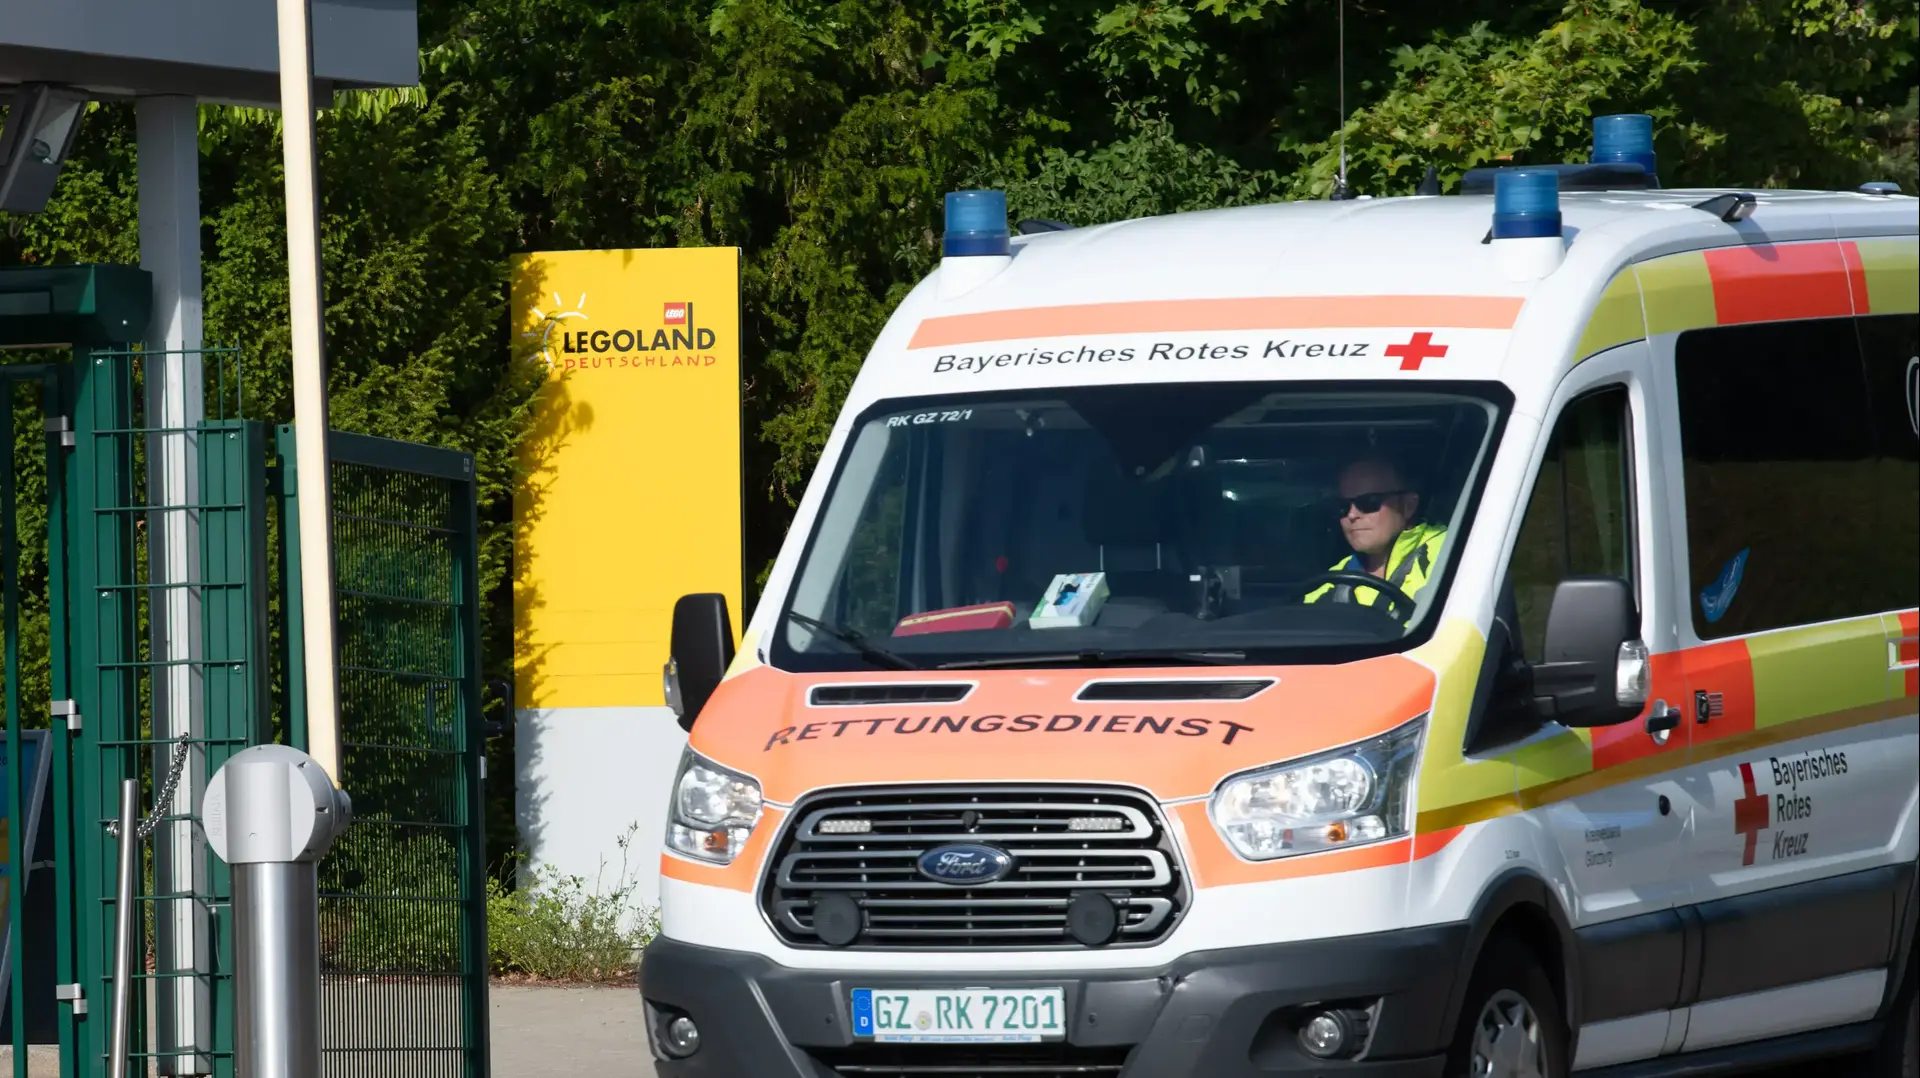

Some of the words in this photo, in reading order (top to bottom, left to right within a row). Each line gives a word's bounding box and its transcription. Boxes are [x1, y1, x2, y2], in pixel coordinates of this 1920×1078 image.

[563, 302, 716, 354] LEGOLAND
[665, 308, 685, 319] LEGO
[563, 355, 716, 371] DEUTSCHLAND
[932, 344, 1136, 376] Bayerisches
[1148, 341, 1250, 362] Rotes
[1261, 339, 1371, 360] Kreuz
[886, 414, 912, 428] RK
[912, 412, 939, 425] GZ
[940, 409, 973, 422] 72/1
[762, 714, 1256, 752] RETTUNGSDIENST
[1769, 749, 1848, 792] Bayerisches
[1776, 793, 1812, 823] Rotes
[1772, 831, 1809, 861] Kreuz
[935, 852, 986, 875] Ford
[860, 1016, 869, 1027] D
[874, 995, 912, 1029] GZ
[935, 995, 974, 1029] RK
[982, 995, 1059, 1029] 7201
